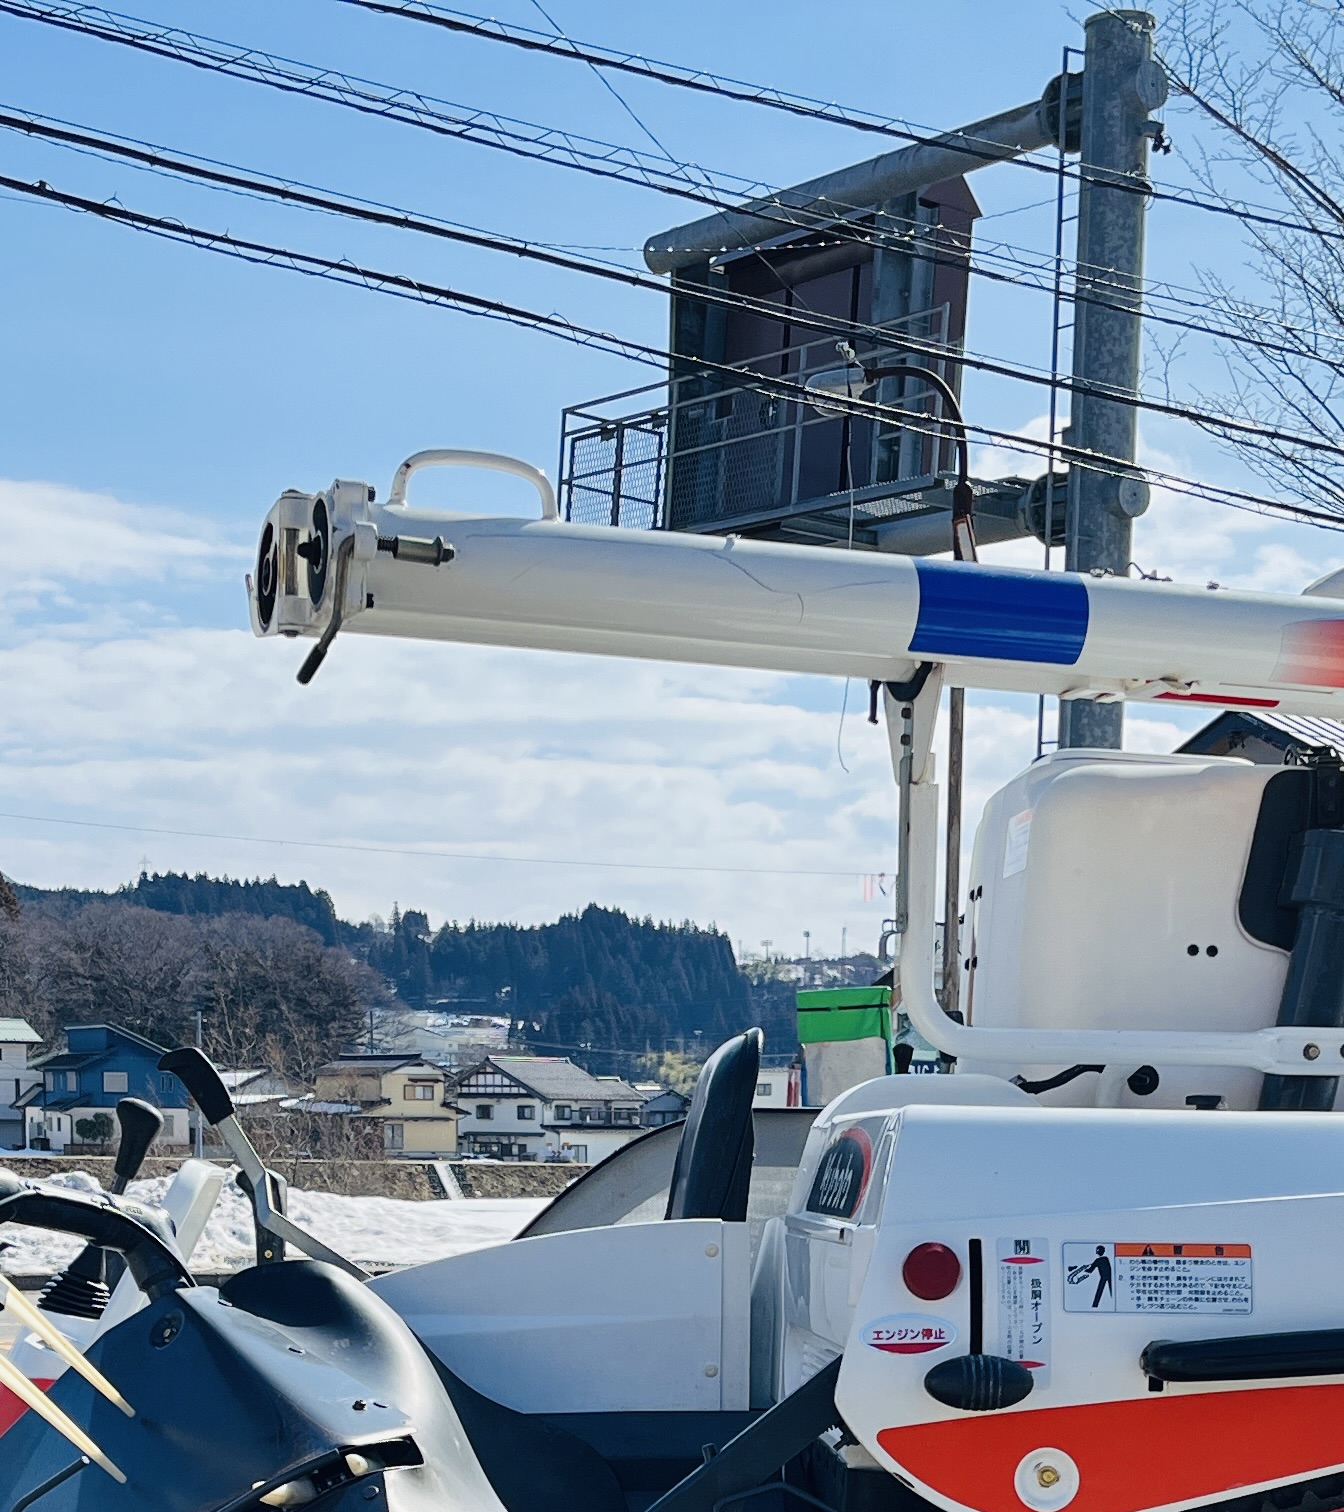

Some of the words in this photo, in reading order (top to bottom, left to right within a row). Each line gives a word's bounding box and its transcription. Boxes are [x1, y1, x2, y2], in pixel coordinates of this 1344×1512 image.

[871, 1327, 946, 1341] エンジン停止
